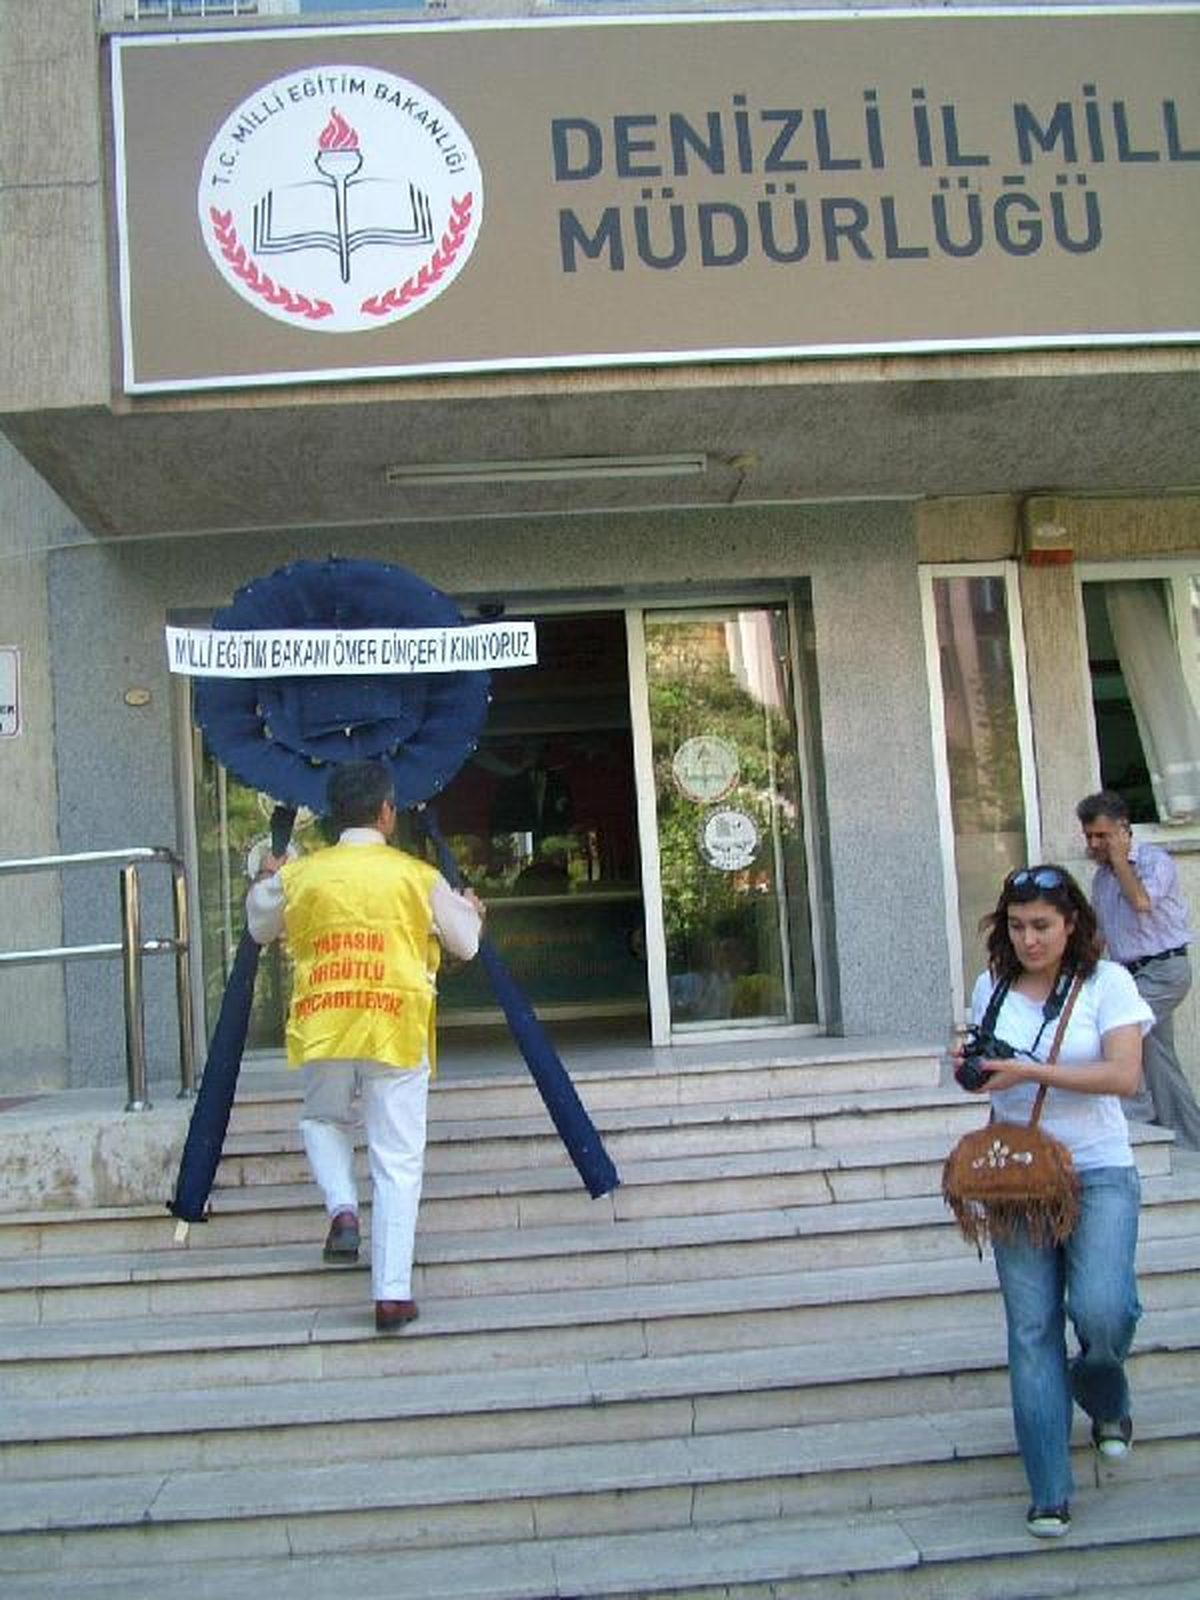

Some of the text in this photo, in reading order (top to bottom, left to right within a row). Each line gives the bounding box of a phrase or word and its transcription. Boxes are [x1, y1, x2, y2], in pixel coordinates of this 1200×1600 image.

[212, 73, 467, 186] T.C. MİLLİ EĞİTİM BAKANLIĞI
[551, 83, 1200, 182] DENİZLİ İL MİLL
[559, 174, 1103, 273] MÜDÜRLÜĞÜ
[175, 631, 213, 668] MİLLİ
[216, 633, 267, 669] EĞİTİM
[271, 639, 330, 668] BAKANI
[333, 633, 377, 666] ÖMER
[451, 631, 529, 662] KINIYORUZ
